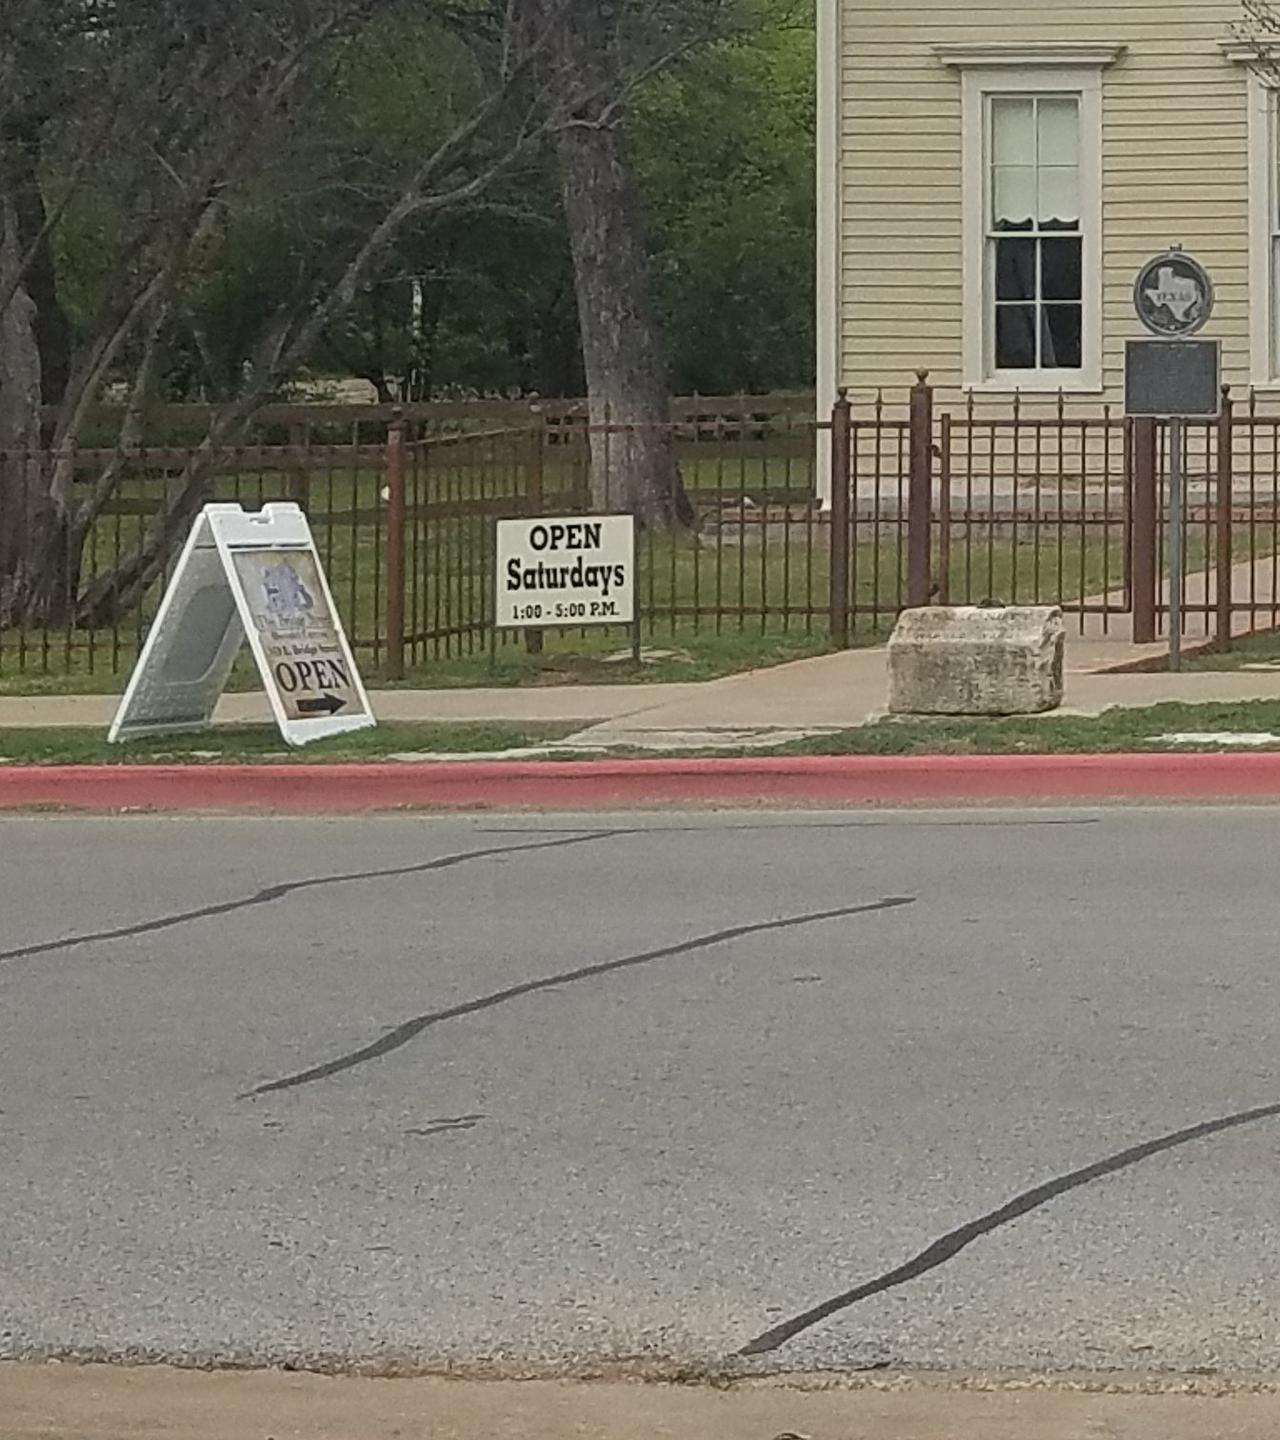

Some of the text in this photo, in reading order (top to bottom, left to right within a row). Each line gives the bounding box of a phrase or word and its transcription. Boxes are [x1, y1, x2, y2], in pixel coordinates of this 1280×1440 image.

[529, 523, 602, 551] OPEN
[506, 555, 625, 596] Saturdays
[513, 604, 543, 619] 1:00
[555, 603, 586, 618] 5:00
[590, 601, 620, 616] P.M.
[275, 659, 351, 692] OPEN
